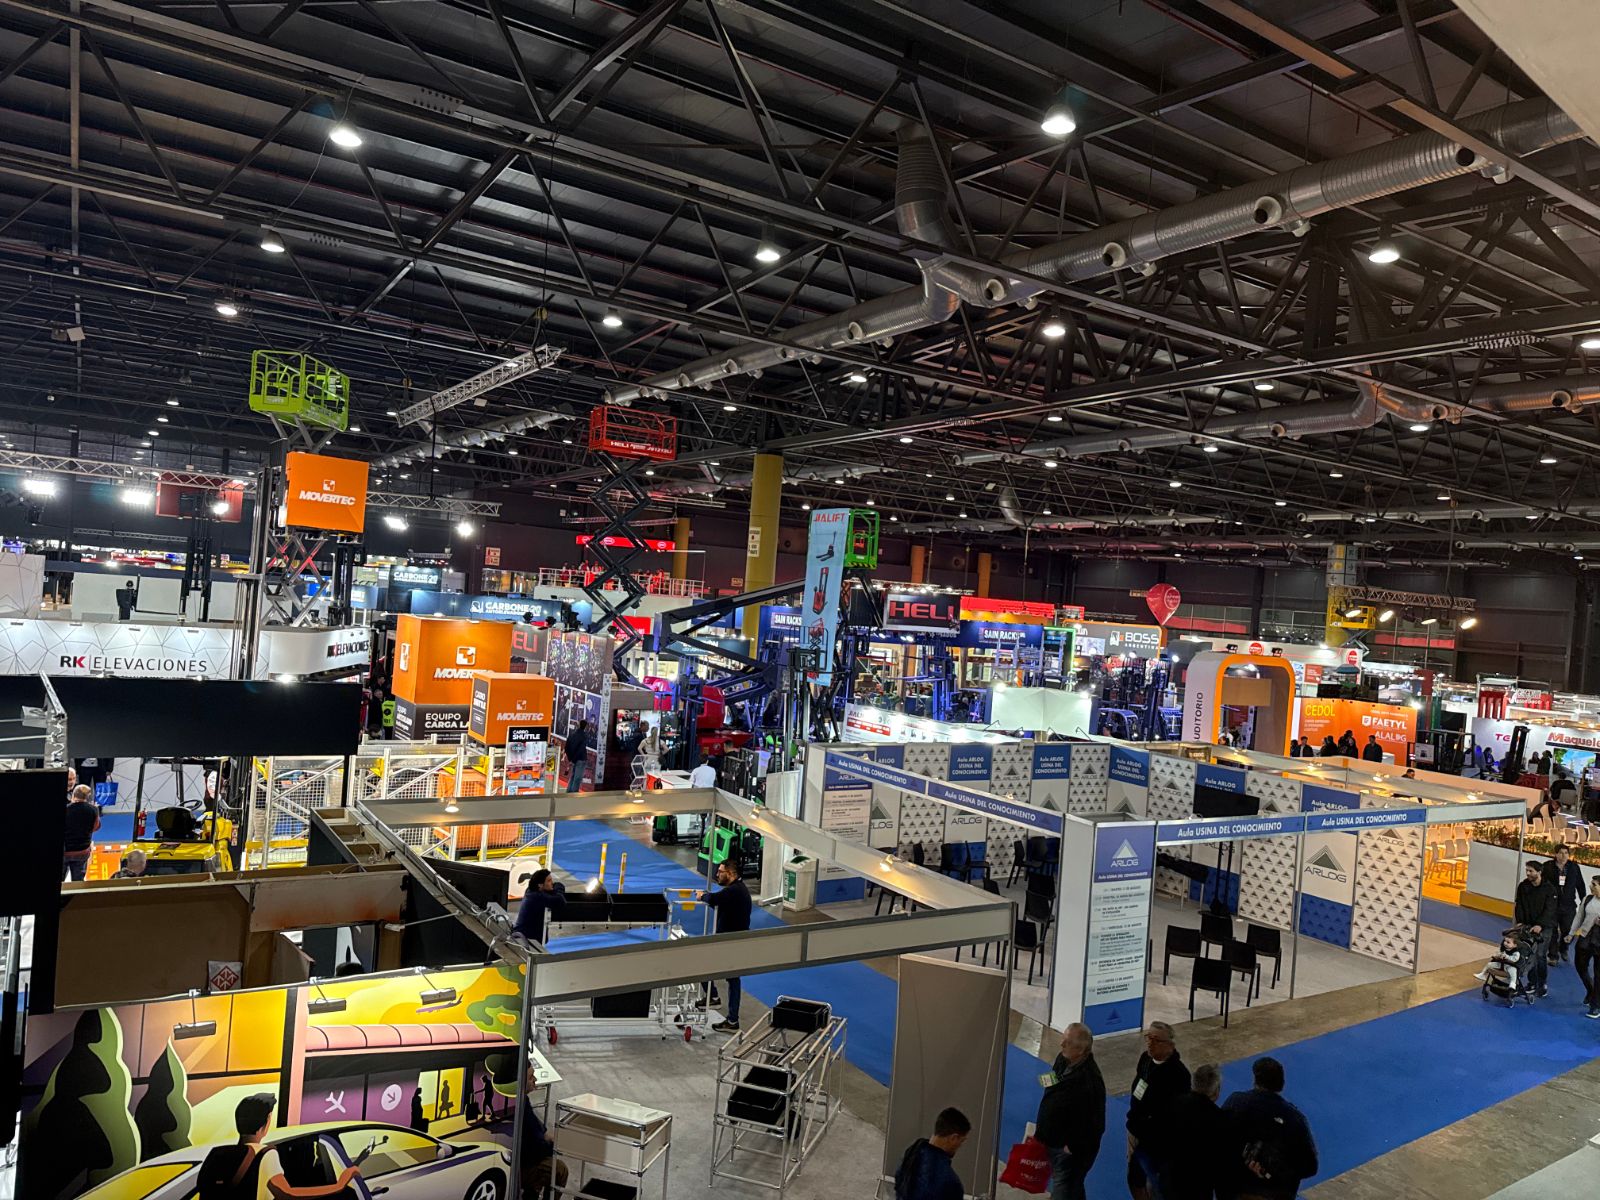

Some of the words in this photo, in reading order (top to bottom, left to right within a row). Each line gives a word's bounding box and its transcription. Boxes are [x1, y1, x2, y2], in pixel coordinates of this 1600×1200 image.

[299, 490, 356, 506] MOVERTEC
[393, 571, 428, 581] CARBONE
[485, 601, 529, 613] CARBONE
[889, 600, 954, 620] HELI
[774, 614, 786, 625] SAIN
[984, 629, 999, 639] SAIN
[1125, 632, 1160, 645] BOSS
[512, 630, 538, 653] ELI
[60, 655, 86, 669] RK
[93, 656, 208, 673] ELEVACIONES
[496, 712, 544, 721] MOVERTEC
[1194, 692, 1204, 740] UDITORIO
[1305, 704, 1335, 717] CEDOL
[425, 713, 461, 722] EQUIPO
[1372, 716, 1407, 730] FAETYL
[424, 721, 458, 729] CARGA
[1126, 759, 1142, 768] ARLOG
[838, 759, 848, 767] Aula
[848, 762, 862, 772] USINA
[862, 766, 871, 774] DEL
[871, 768, 907, 784] CONOCIMIENTO
[1111, 769, 1145, 781] CONOCIMIENTO
[1204, 777, 1217, 786] Aula
[1217, 779, 1236, 789] ARLOG
[945, 791, 957, 800] Aula
[958, 793, 976, 805] USINA
[977, 799, 987, 809] DEL
[988, 802, 1036, 822] CONOCIMIENTO
[871, 820, 894, 830] LOG
[950, 816, 983, 825] ARLOG
[1321, 818, 1336, 826] Aula
[1336, 817, 1354, 826] USINA
[1355, 816, 1365, 824] DEL
[1365, 813, 1407, 823] CONOCIMIENTO
[1178, 828, 1194, 838] Aula
[1195, 826, 1217, 837] USINA
[1219, 825, 1230, 834] DEL
[1231, 821, 1282, 834] CONOCIMIENTO
[1376, 836, 1405, 847] ARLOG
[1110, 858, 1139, 868] ARLOG
[1304, 865, 1347, 883] ARLOG
